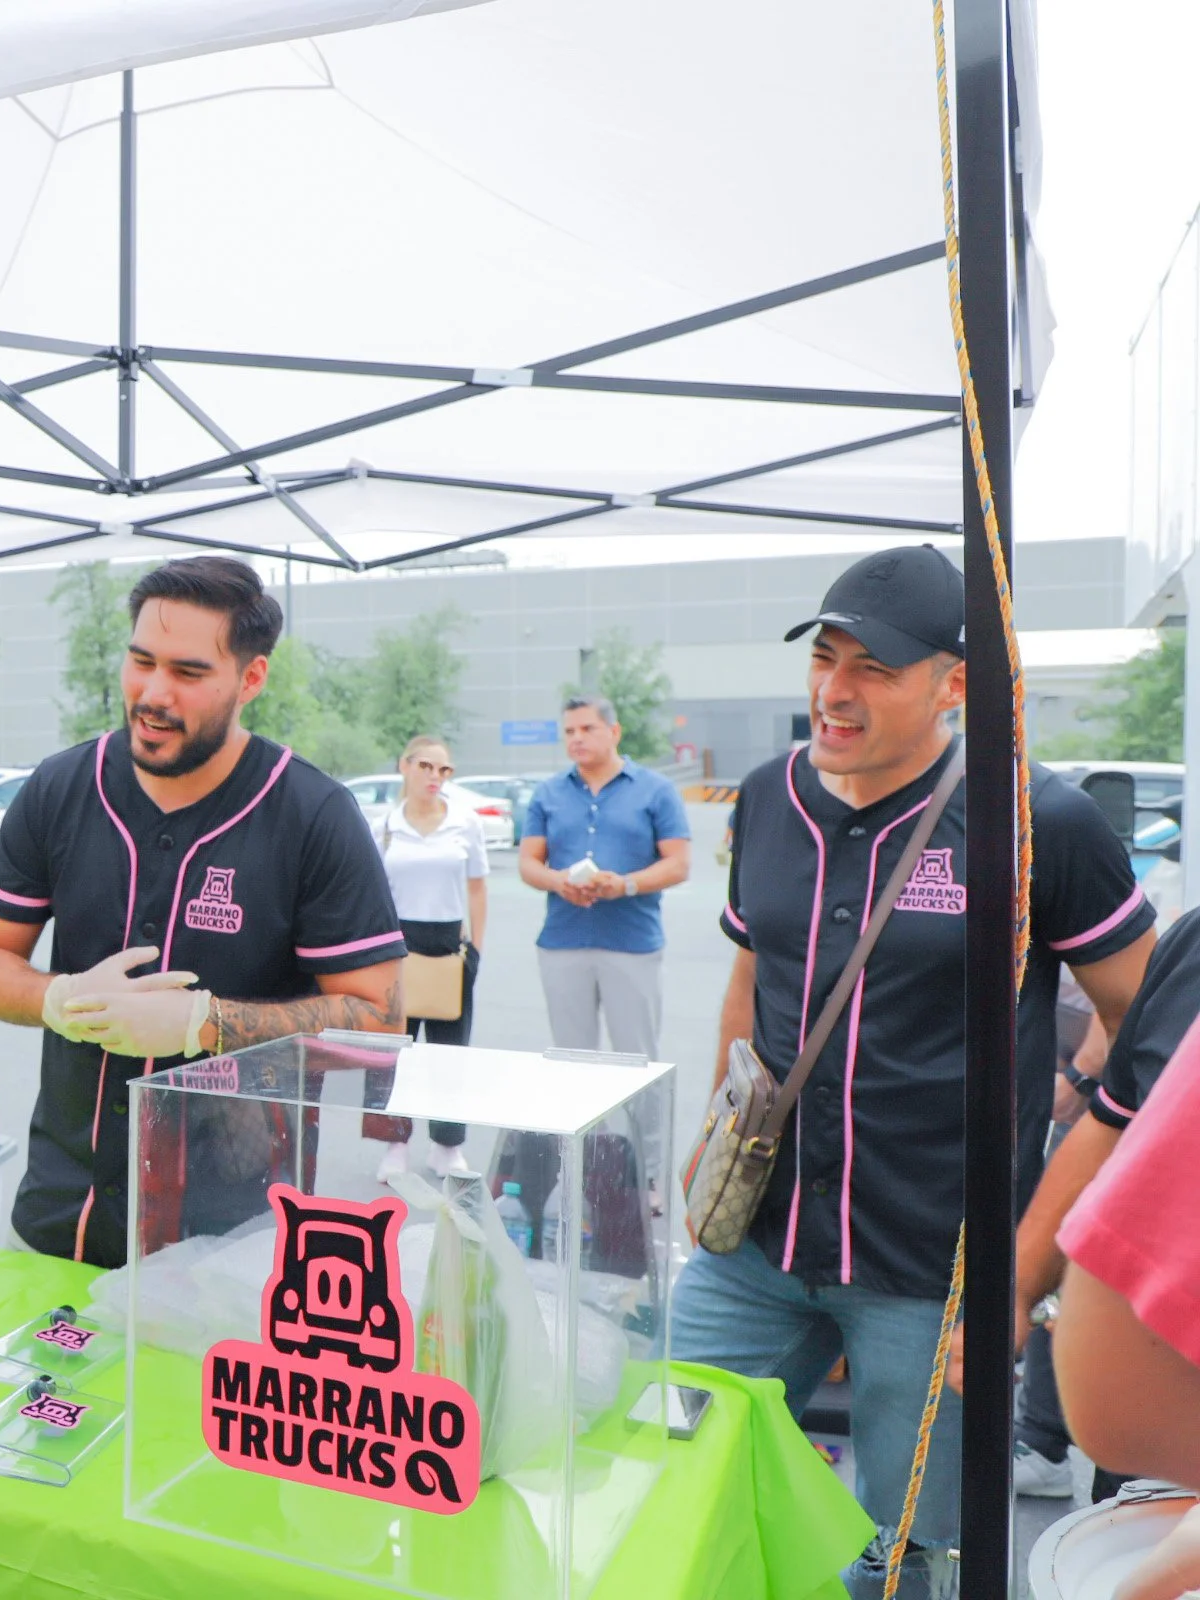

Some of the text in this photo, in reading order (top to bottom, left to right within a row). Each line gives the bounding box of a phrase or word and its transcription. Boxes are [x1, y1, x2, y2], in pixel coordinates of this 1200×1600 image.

[896, 897, 945, 909] TRUCKS
[189, 904, 239, 920] MARRANO
[188, 914, 224, 929] TRUCKS
[211, 1357, 465, 1450] MARRANO
[211, 1406, 397, 1488] TRUCKS
